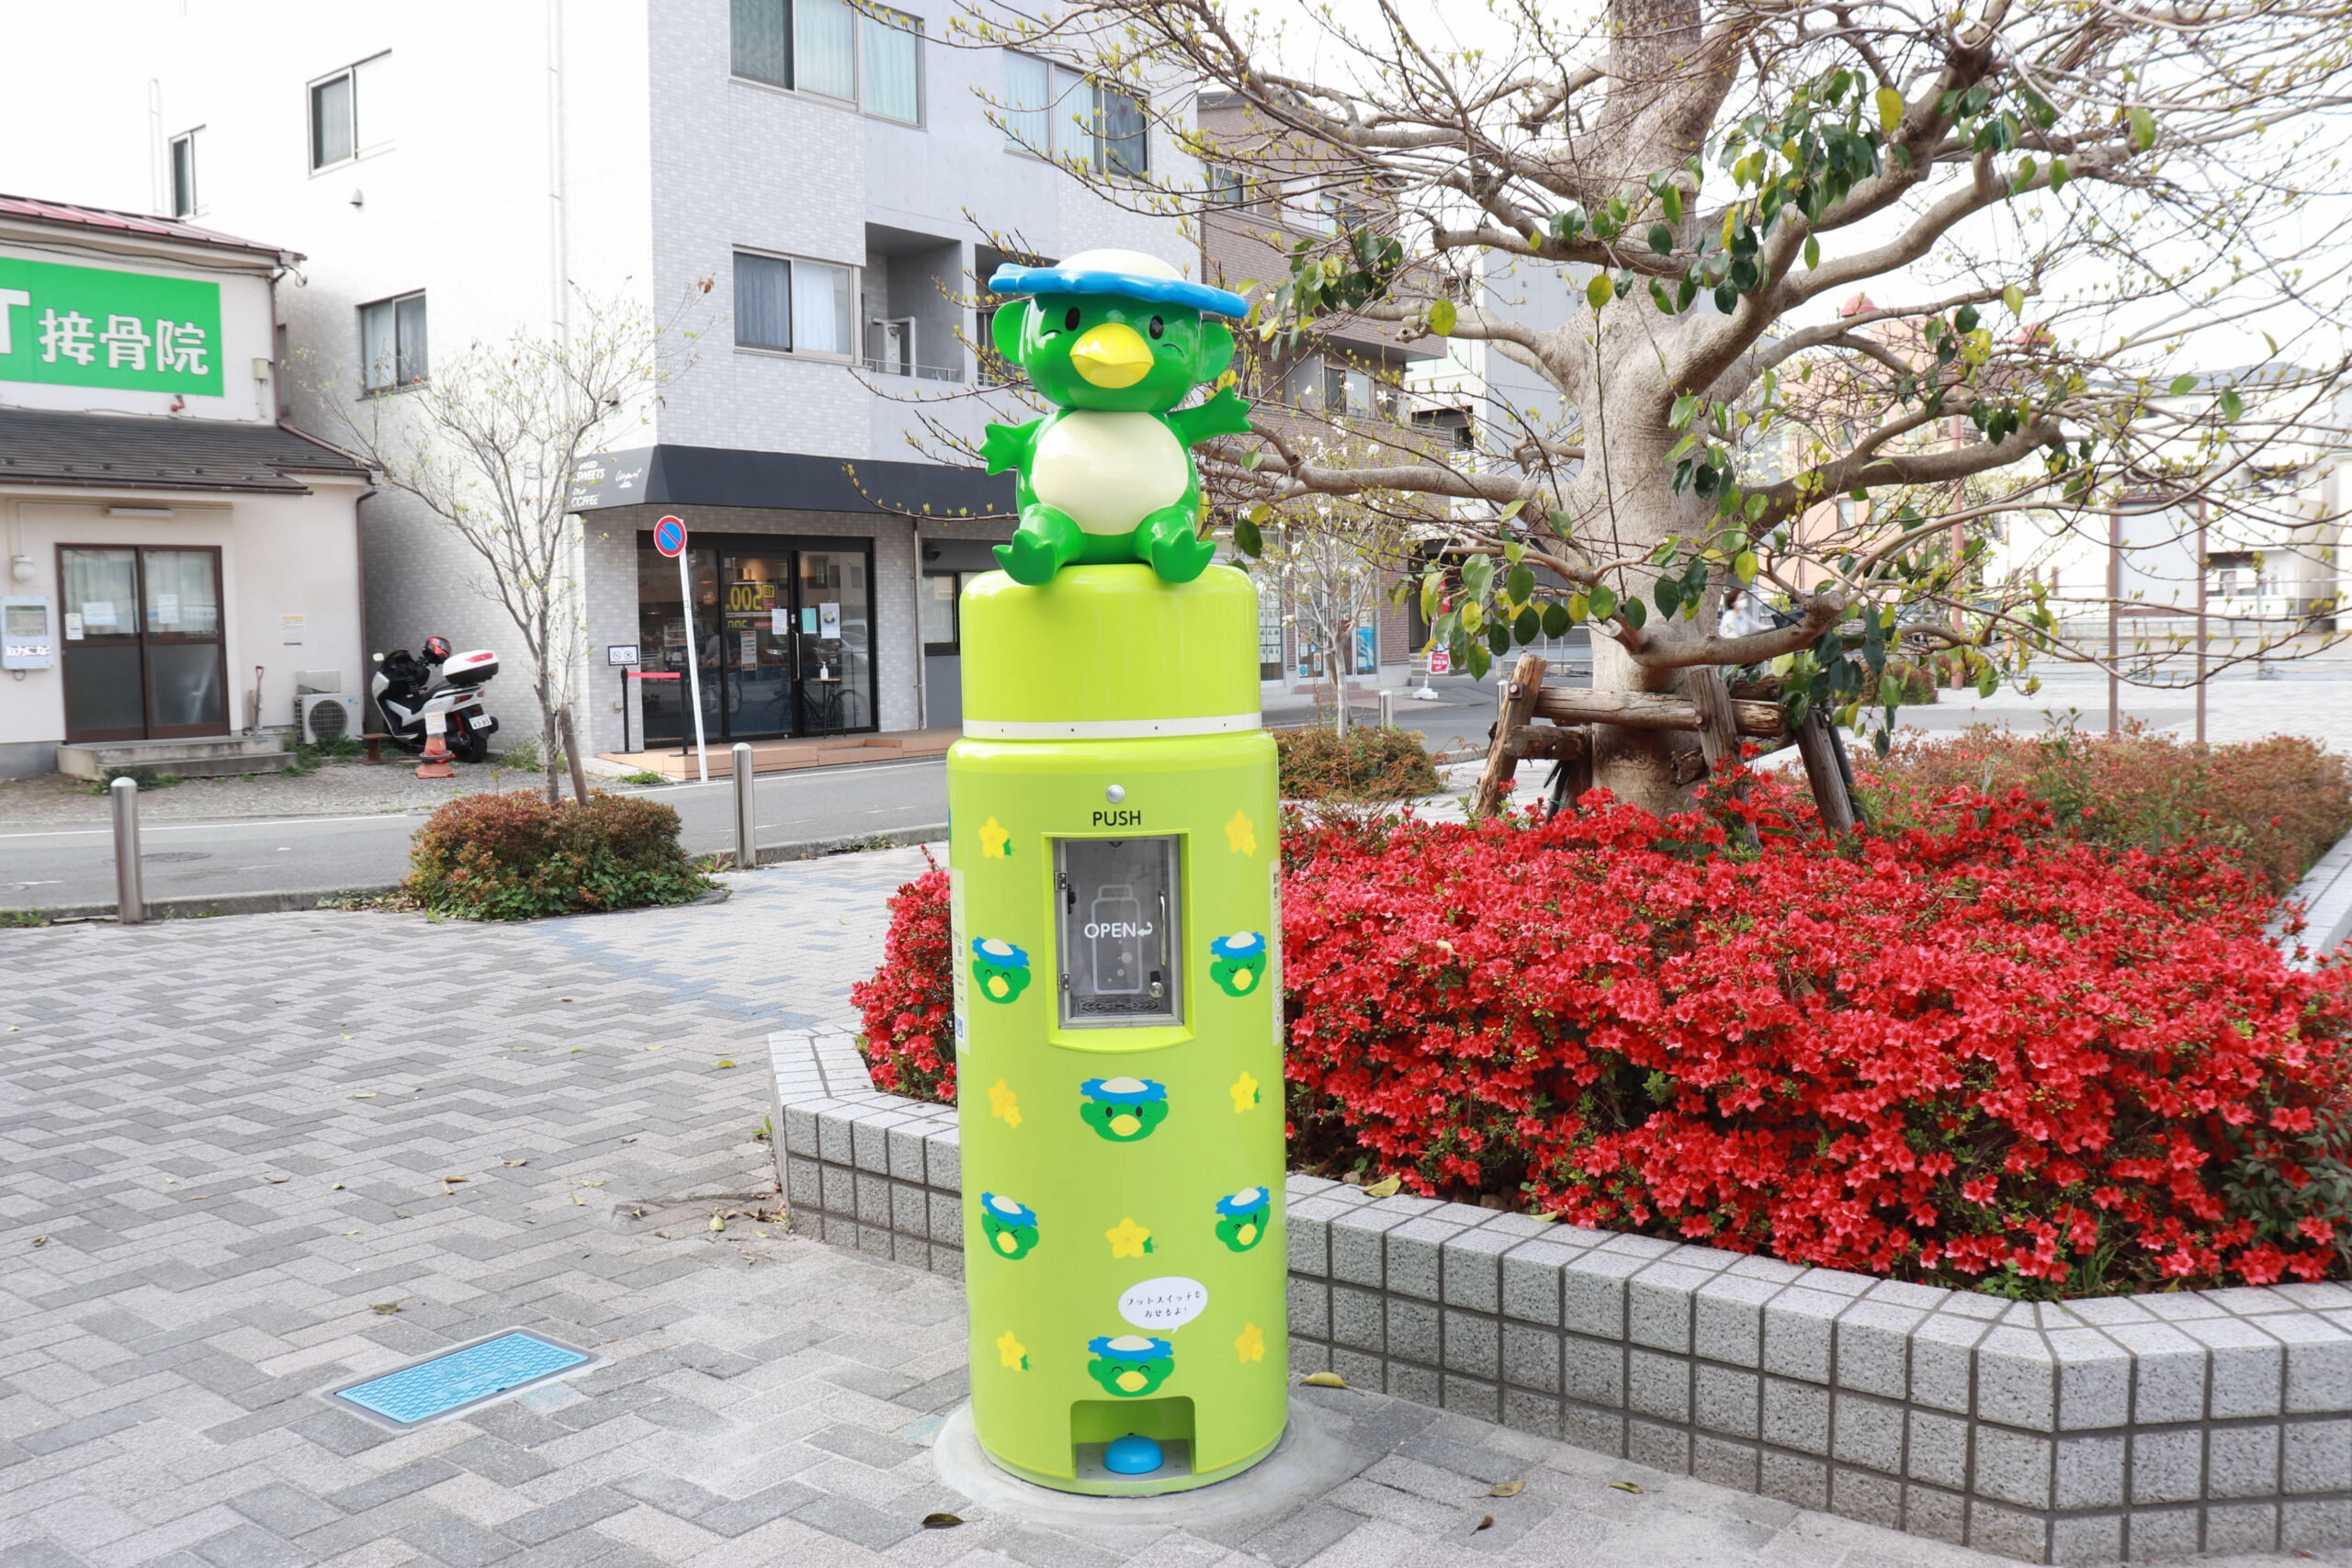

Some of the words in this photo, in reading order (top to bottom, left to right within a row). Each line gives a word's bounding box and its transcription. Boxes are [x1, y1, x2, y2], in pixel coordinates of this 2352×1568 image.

[38, 308, 209, 376] 接骨院
[576, 468, 605, 481] SWEETS
[571, 494, 599, 507] COFFEE
[1092, 810, 1141, 826] PUSH
[1084, 921, 1136, 939] OPEN
